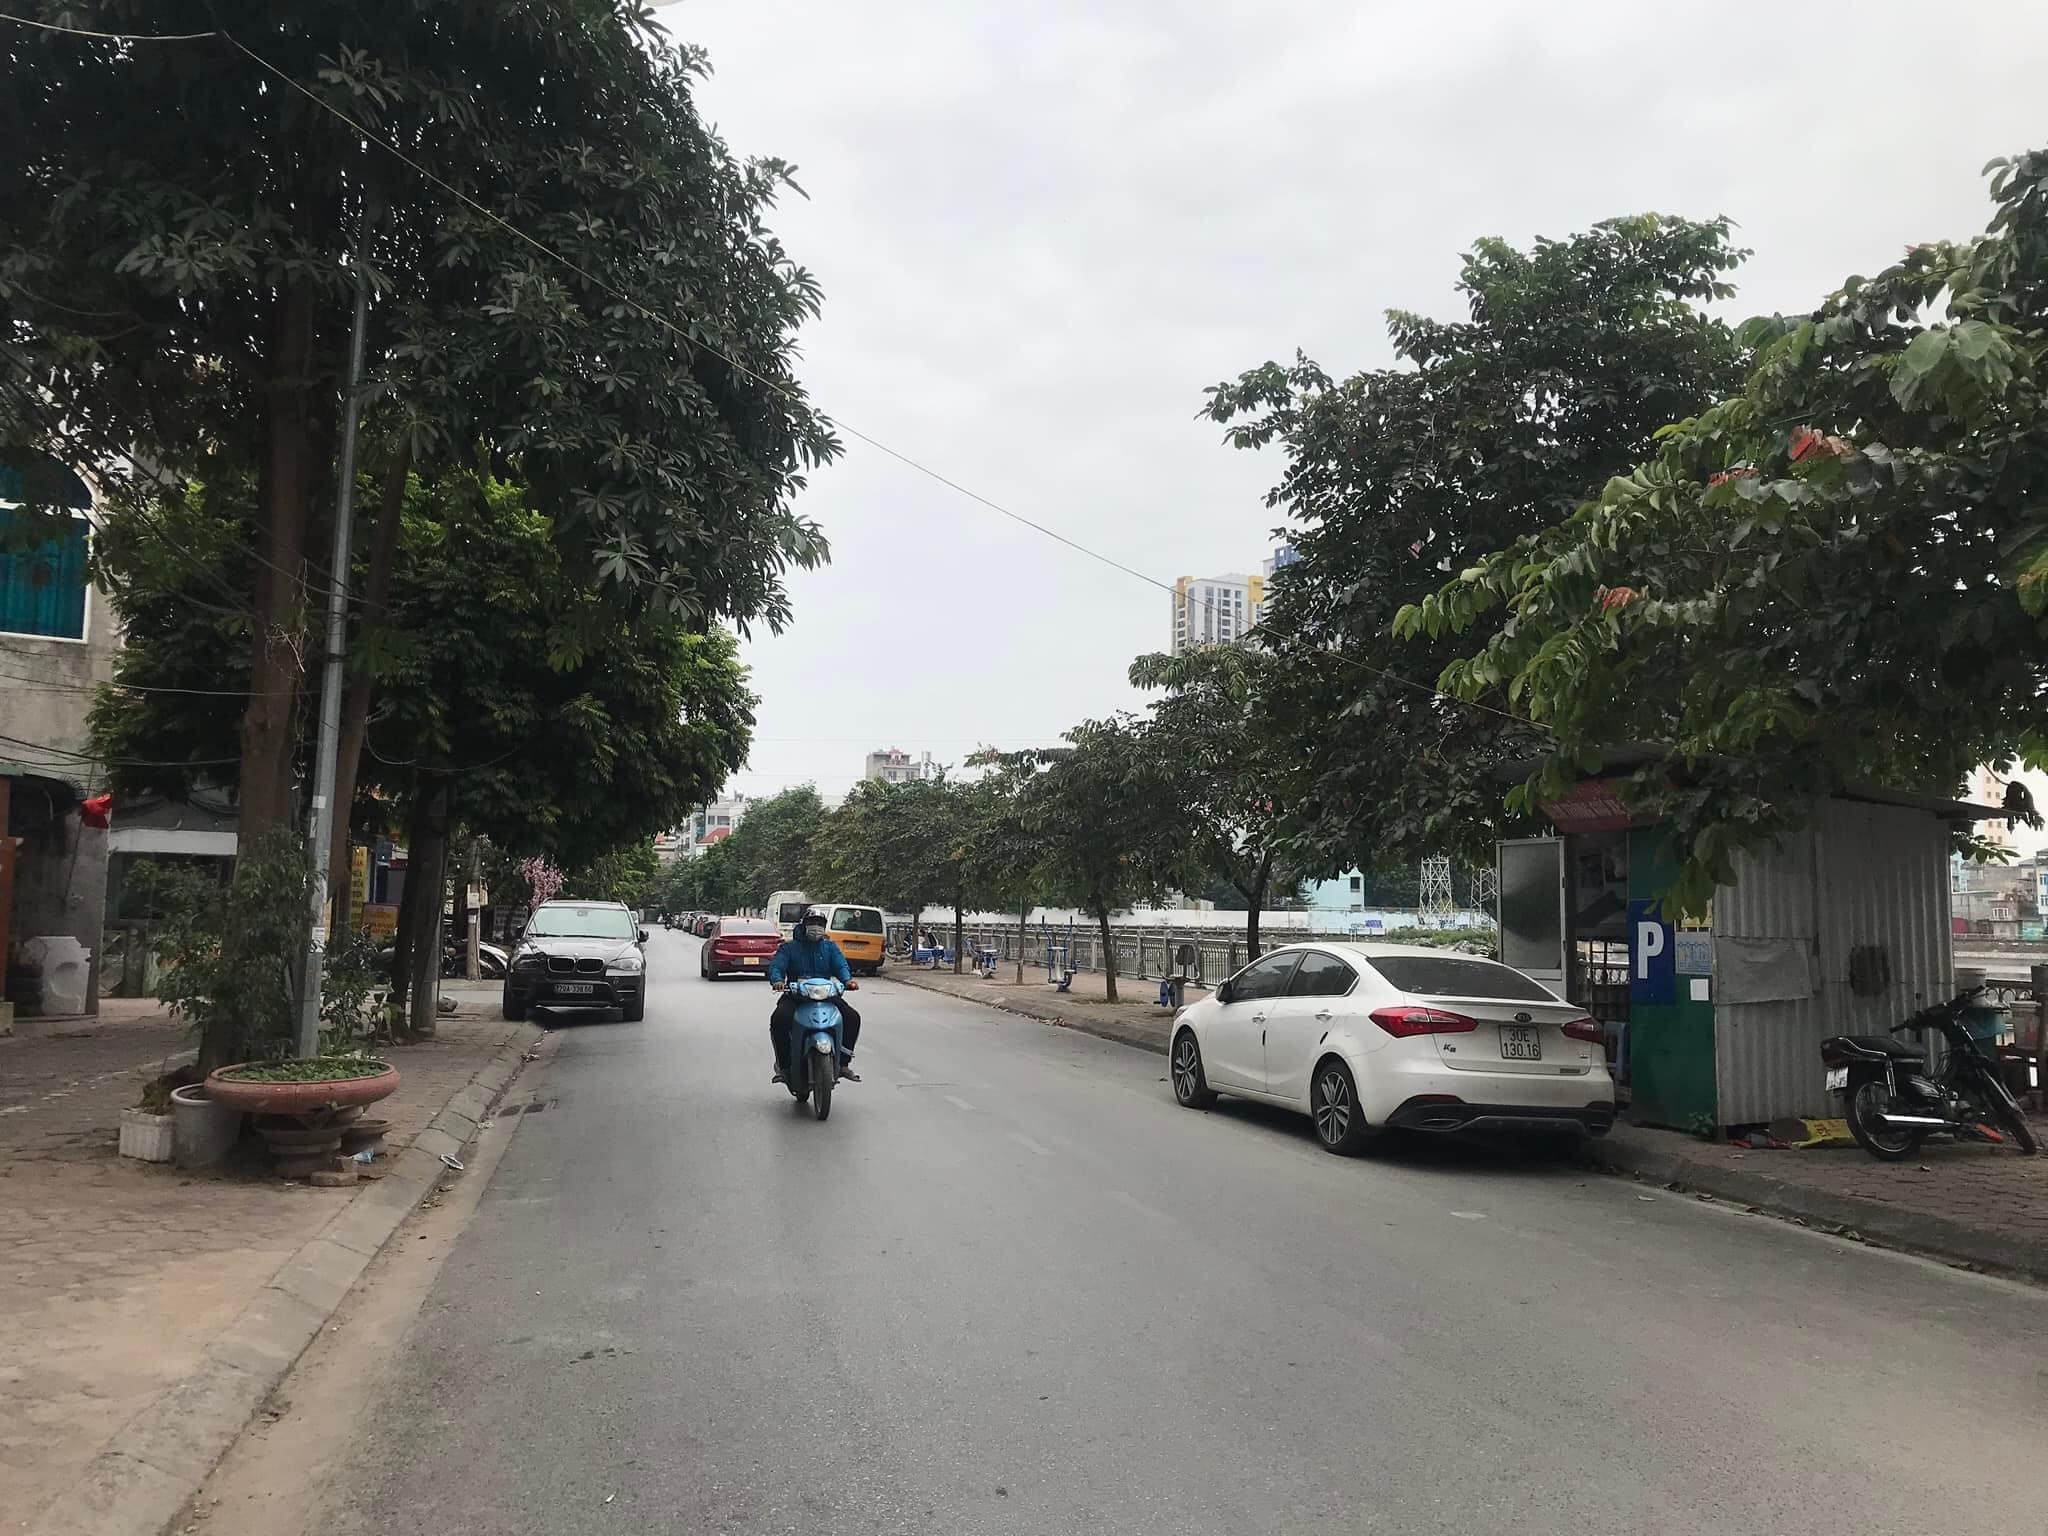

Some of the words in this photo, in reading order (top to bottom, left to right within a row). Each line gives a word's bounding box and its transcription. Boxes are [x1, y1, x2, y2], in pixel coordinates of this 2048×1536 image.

[1638, 921, 1664, 979] P
[1510, 1029, 1530, 1042] 30E
[1503, 1043, 1539, 1058] 130.16
